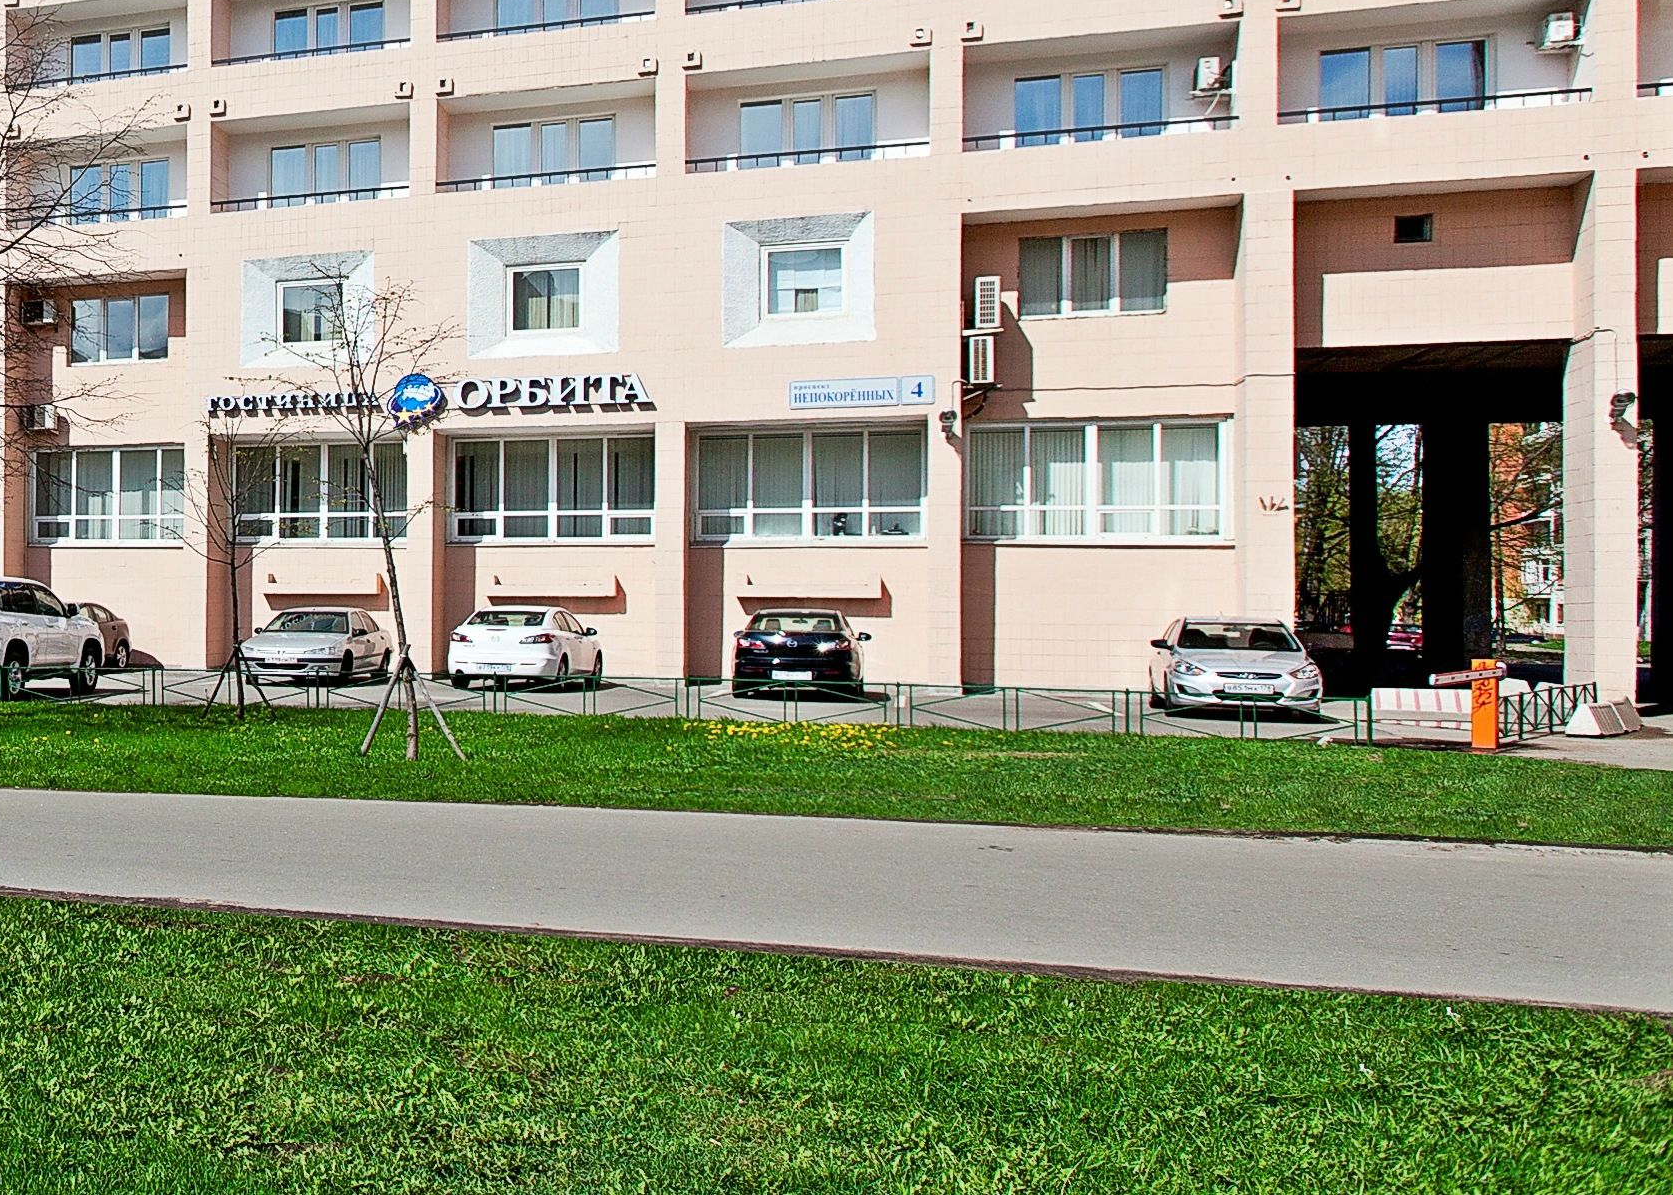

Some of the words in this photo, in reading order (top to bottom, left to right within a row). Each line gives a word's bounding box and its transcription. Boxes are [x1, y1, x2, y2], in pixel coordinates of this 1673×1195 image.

[206, 392, 380, 411] ГОСТИНИЦА
[453, 372, 653, 409] ОРБИТА
[793, 389, 894, 404] НЕПОКОРЁННЫХ
[910, 381, 924, 398] 4
